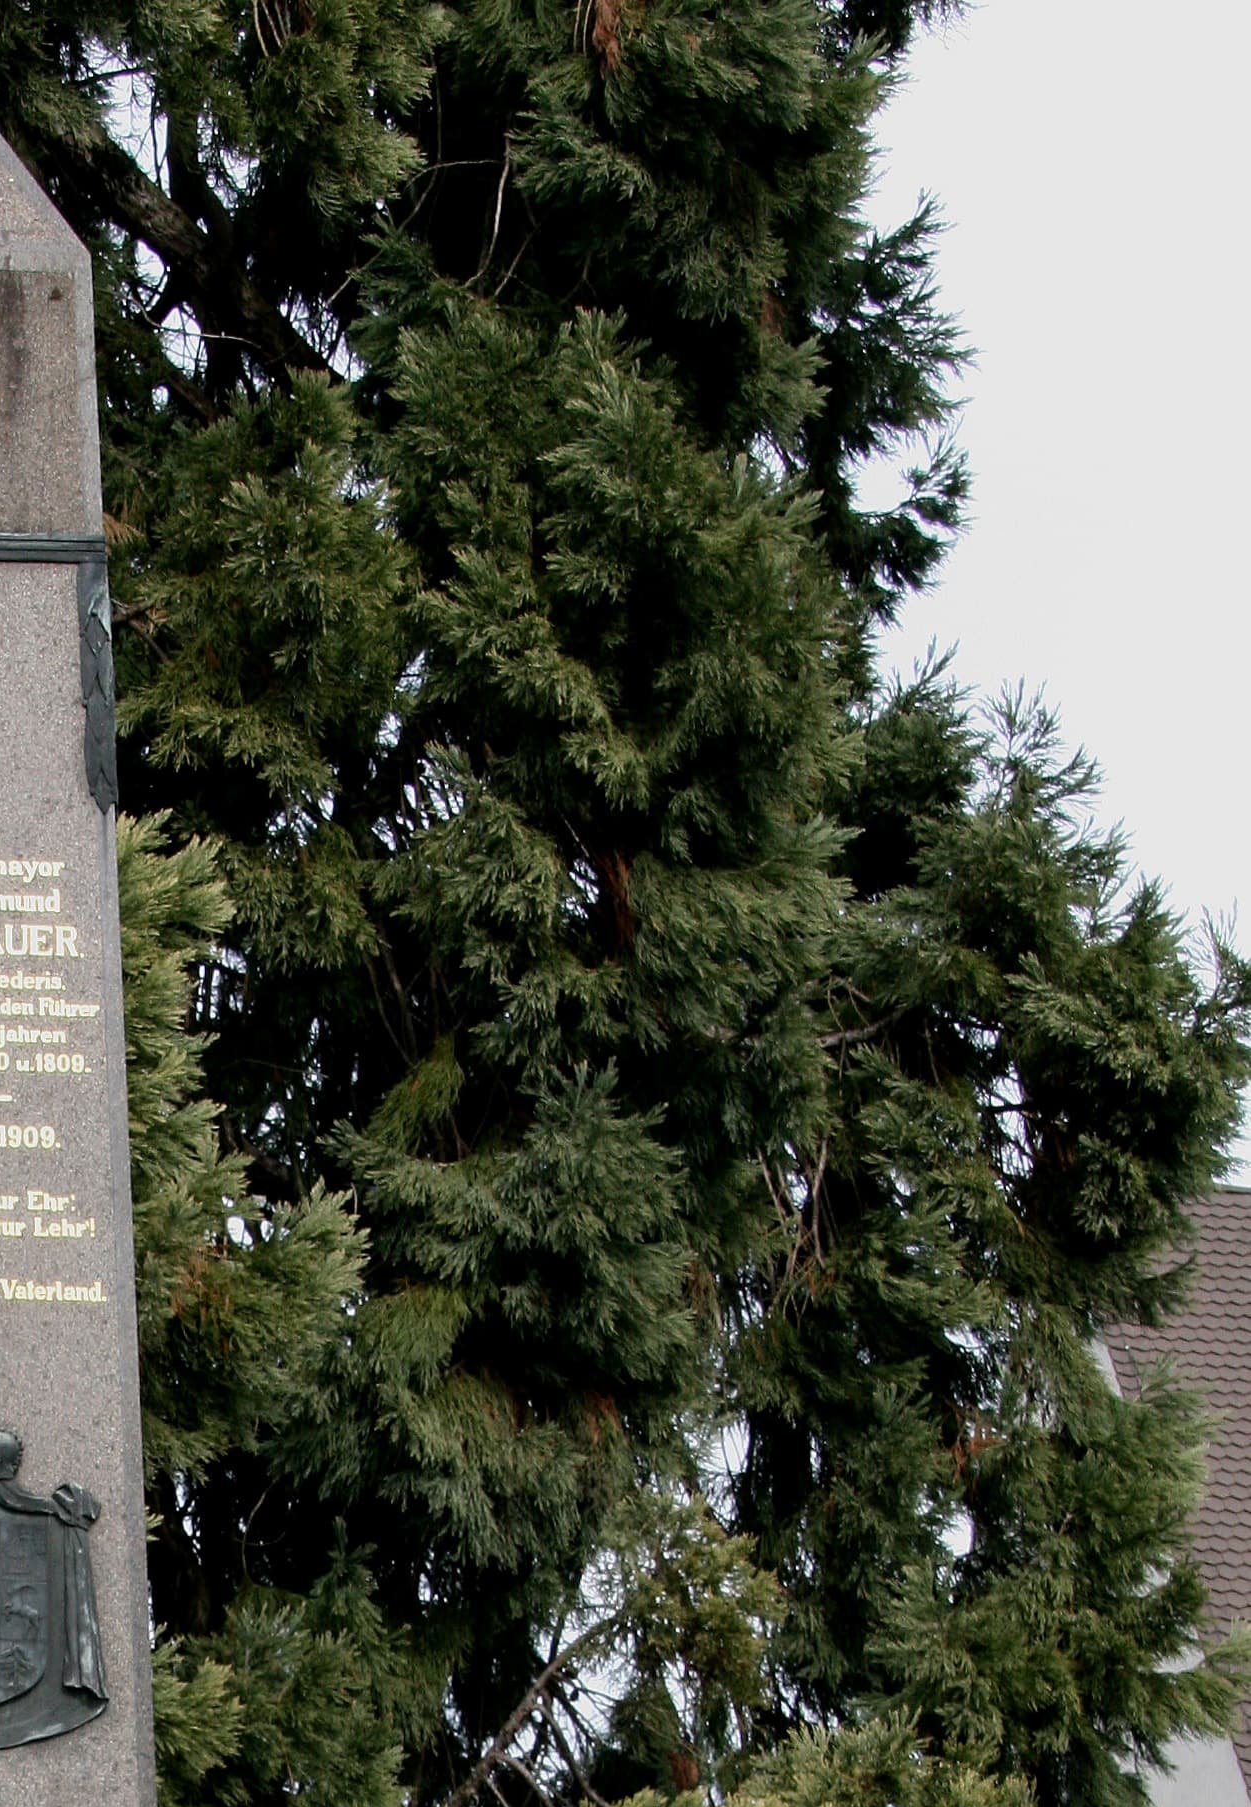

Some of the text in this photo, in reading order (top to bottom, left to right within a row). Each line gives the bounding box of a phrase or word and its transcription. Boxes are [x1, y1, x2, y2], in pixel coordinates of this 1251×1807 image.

[38, 996, 100, 1017] Führer
[16, 1059, 34, 1072] u.
[0, 1278, 108, 1302] Vaterland.
